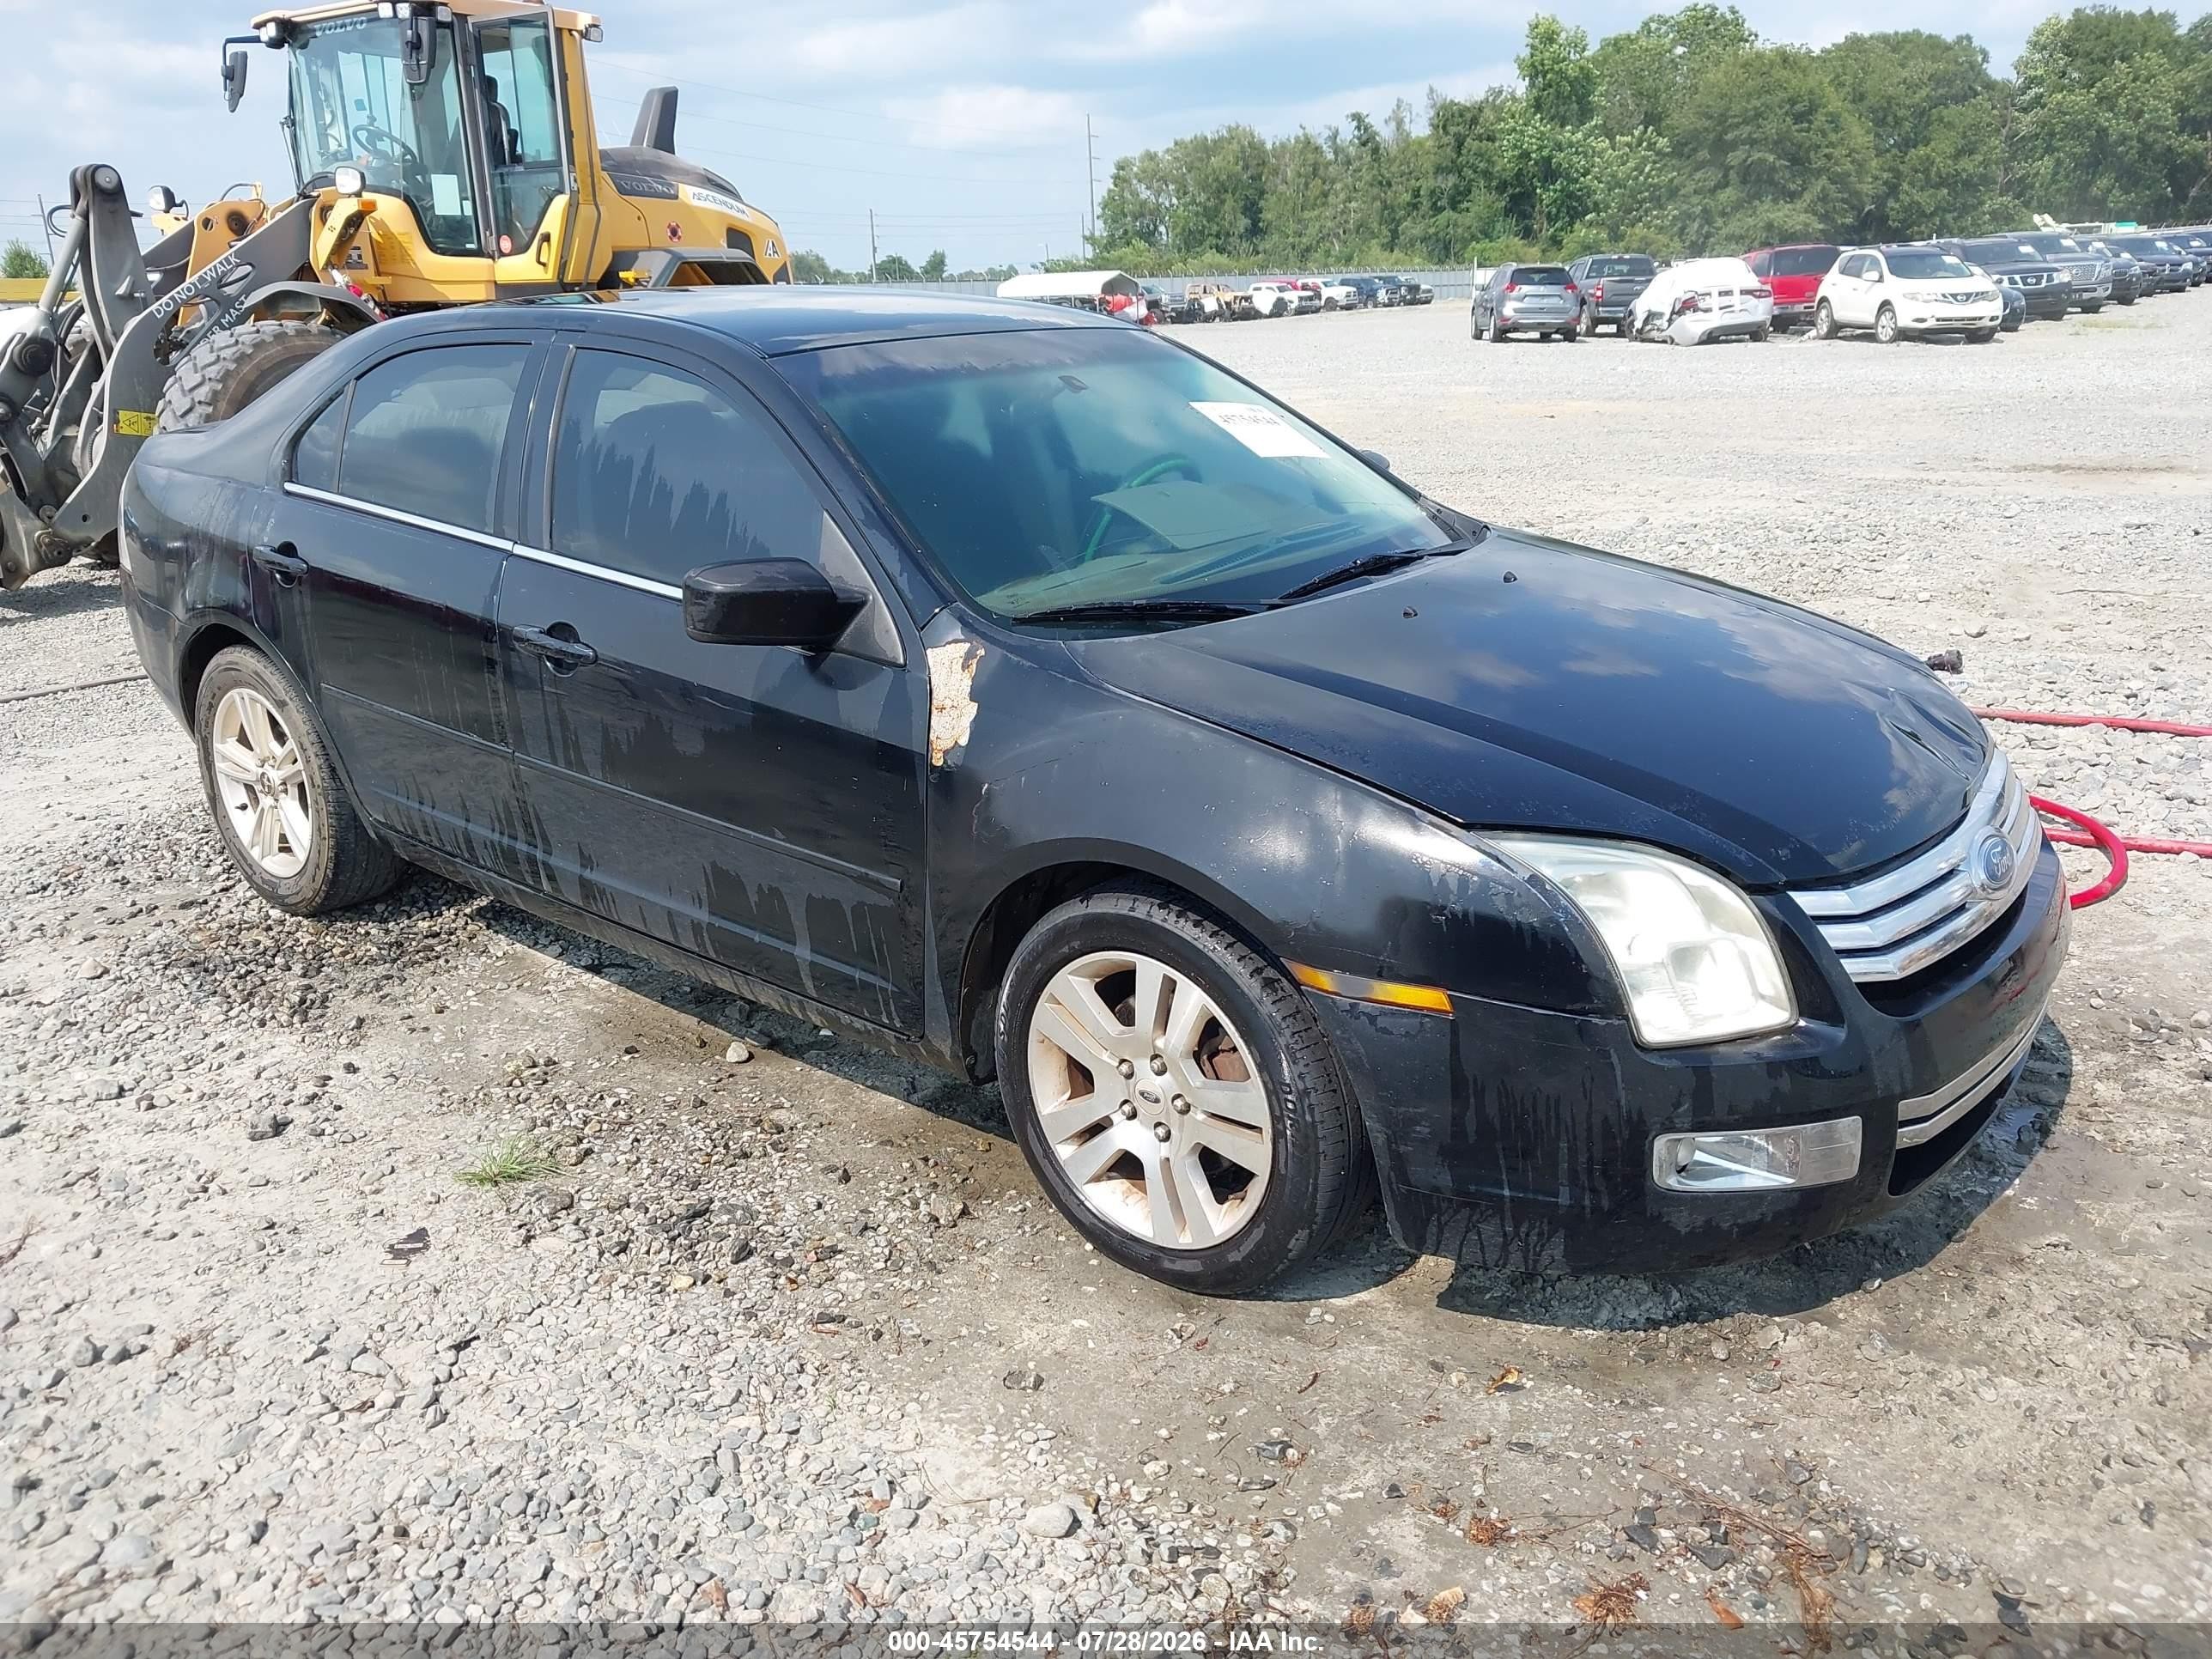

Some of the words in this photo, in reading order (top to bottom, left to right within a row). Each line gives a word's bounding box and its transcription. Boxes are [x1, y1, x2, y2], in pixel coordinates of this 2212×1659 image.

[313, 16, 368, 37] VOLVO
[620, 179, 675, 194] VOLVO
[692, 191, 750, 218] ASCENDUM
[152, 299, 174, 319] DO
[173, 276, 203, 303] NOT
[202, 252, 241, 282] WALK
[220, 294, 249, 328] MAST
